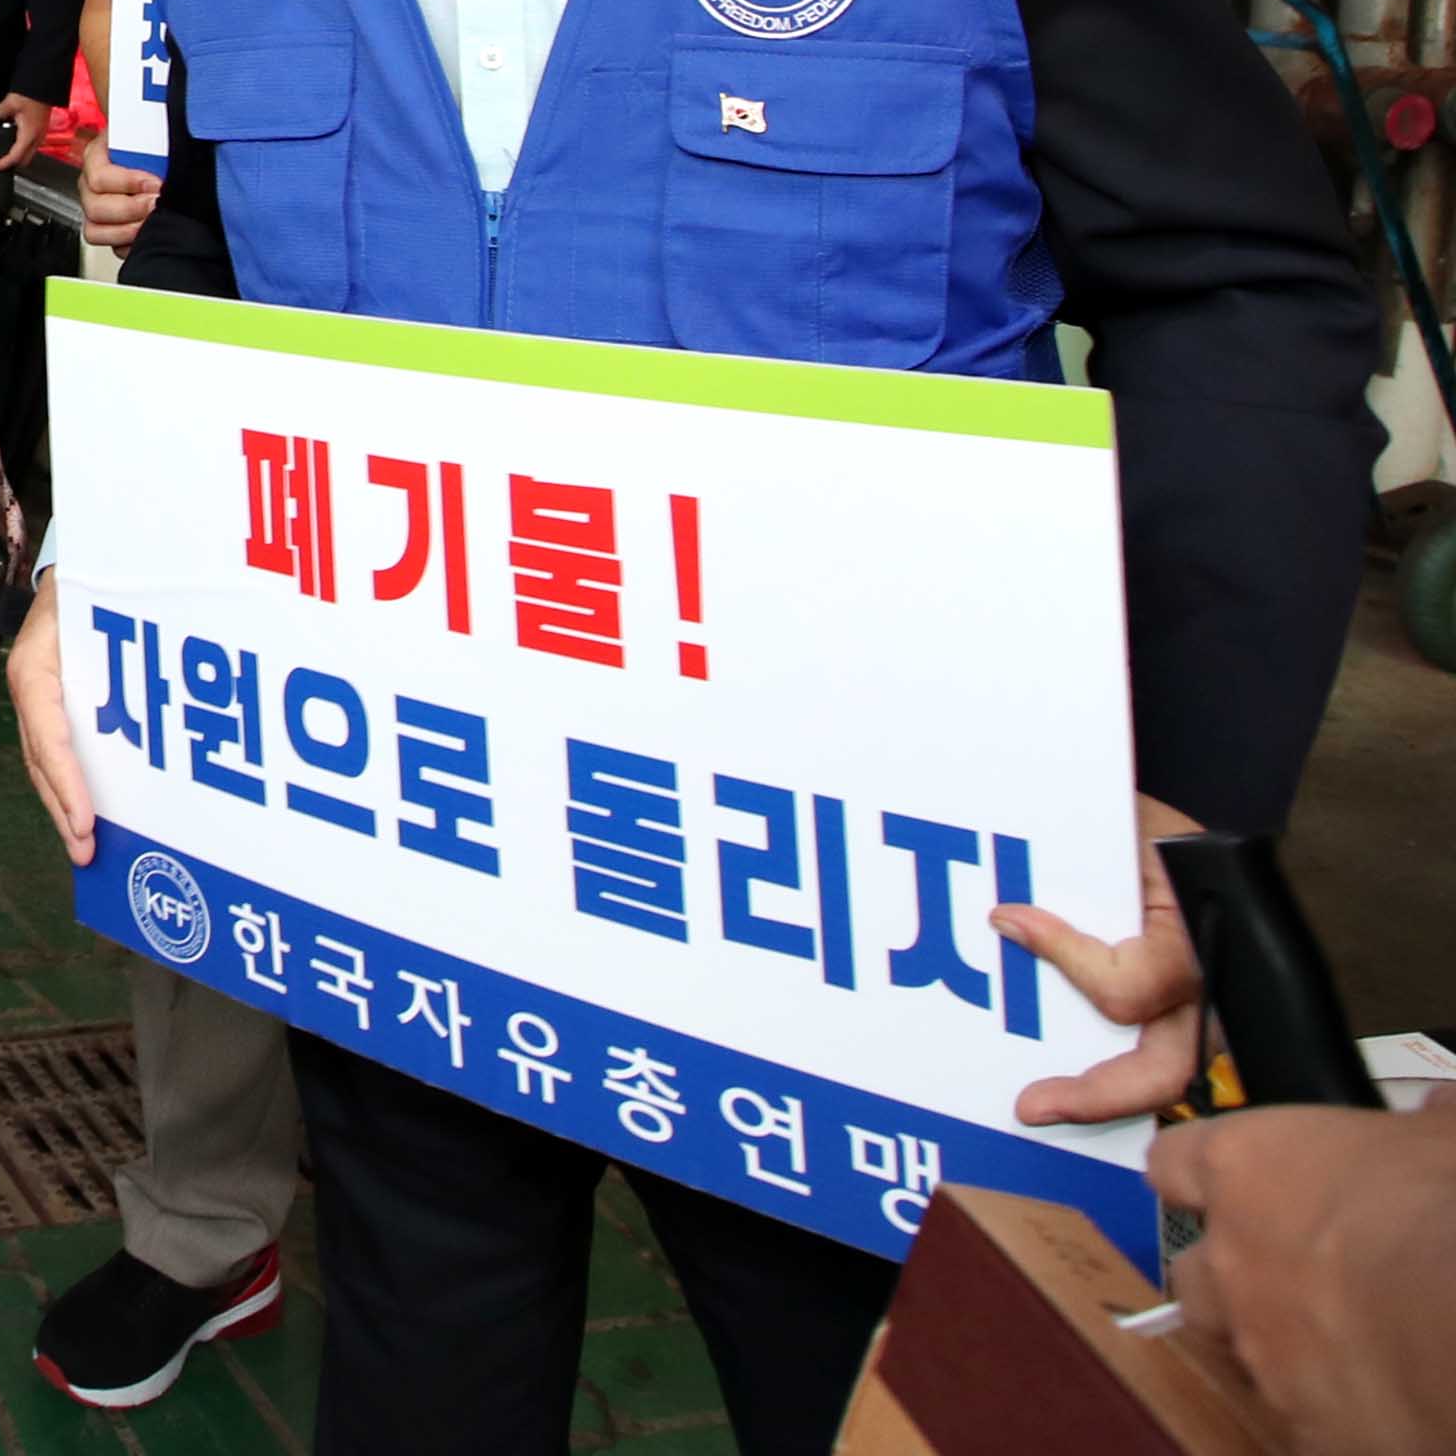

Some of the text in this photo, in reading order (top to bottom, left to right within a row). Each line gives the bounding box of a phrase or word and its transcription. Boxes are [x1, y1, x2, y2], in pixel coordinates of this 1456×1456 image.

[239, 428, 711, 682] 폐기물!
[91, 605, 1042, 1041] 자원으로 돌리자
[143, 886, 193, 929] KFF
[226, 899, 943, 1237] 한국자유총연맹
